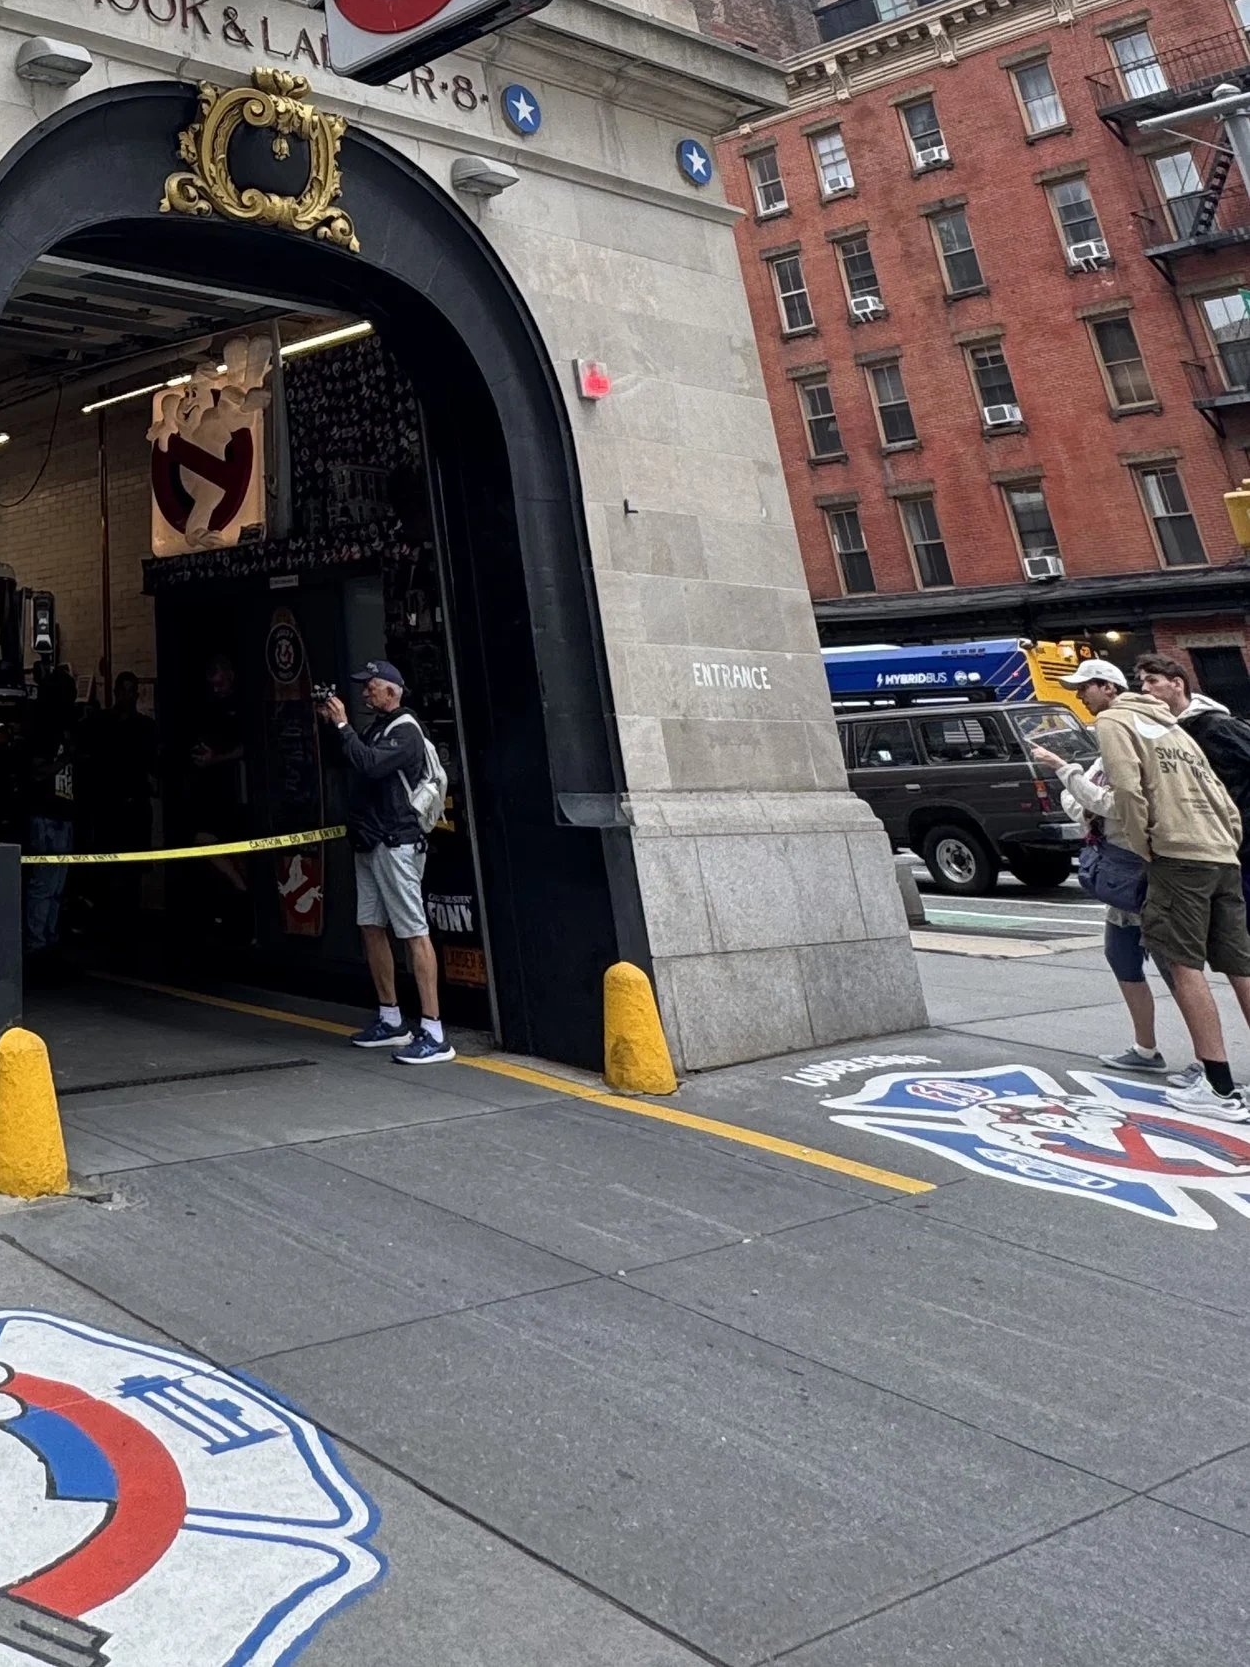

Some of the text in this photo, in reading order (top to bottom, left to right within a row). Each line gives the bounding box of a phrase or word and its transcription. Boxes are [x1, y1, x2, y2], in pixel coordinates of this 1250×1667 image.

[222, 6, 253, 47] &
[260, 15, 438, 101] LAR
[692, 662, 771, 690] ENTRANCE
[1160, 761, 1178, 773] BY
[249, 827, 342, 849] CAUTION DO NOT ENTER
[427, 901, 474, 932] FDNY
